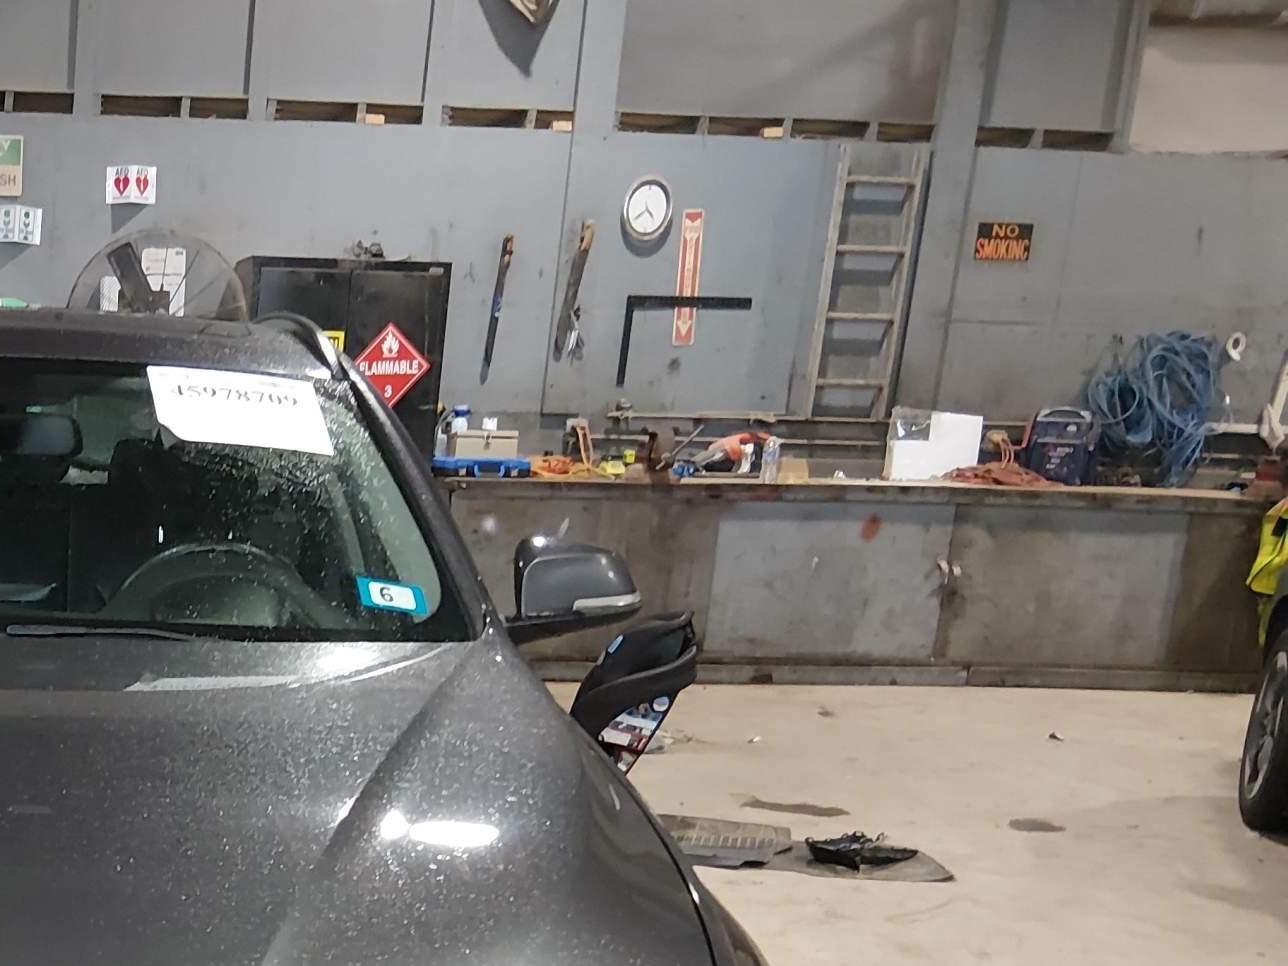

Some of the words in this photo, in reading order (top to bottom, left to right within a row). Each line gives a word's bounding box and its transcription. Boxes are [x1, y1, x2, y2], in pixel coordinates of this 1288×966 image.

[992, 223, 1020, 238] NO
[975, 238, 1030, 260] SMOKING
[384, 384, 393, 398] 3
[379, 586, 394, 603] 6
